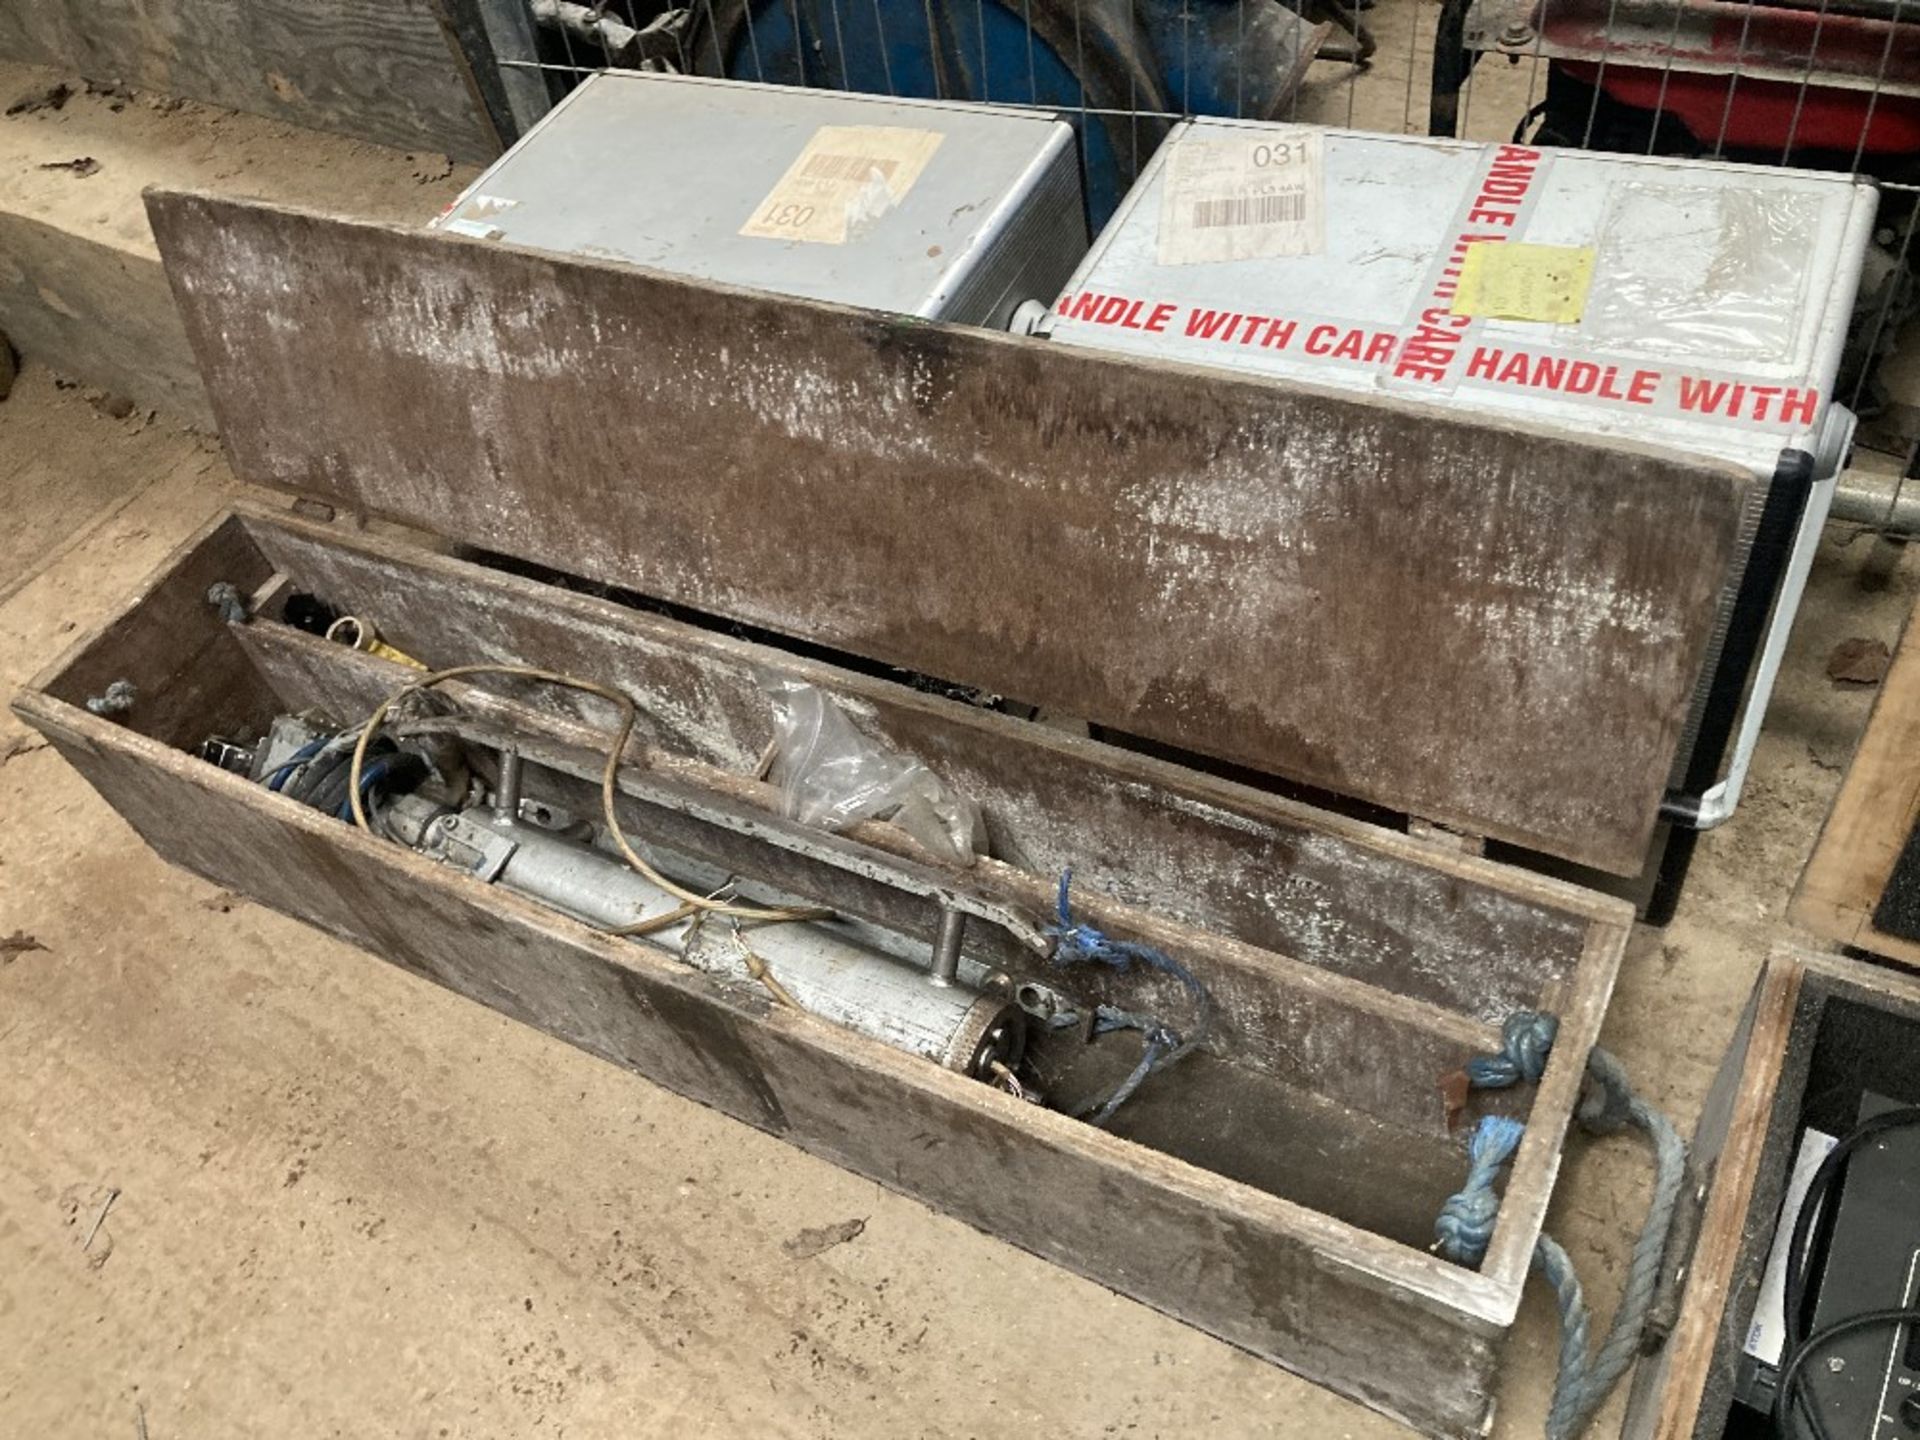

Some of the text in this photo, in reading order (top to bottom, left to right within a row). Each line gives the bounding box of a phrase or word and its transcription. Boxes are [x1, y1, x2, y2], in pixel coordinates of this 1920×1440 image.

[1254, 142, 1307, 168] 031
[763, 204, 815, 226] 031
[1184, 308, 1296, 349] WITH
[1304, 325, 1408, 366] CAR
[1393, 308, 1470, 382] CARE
[1466, 347, 1818, 425] HANDLE WITH
